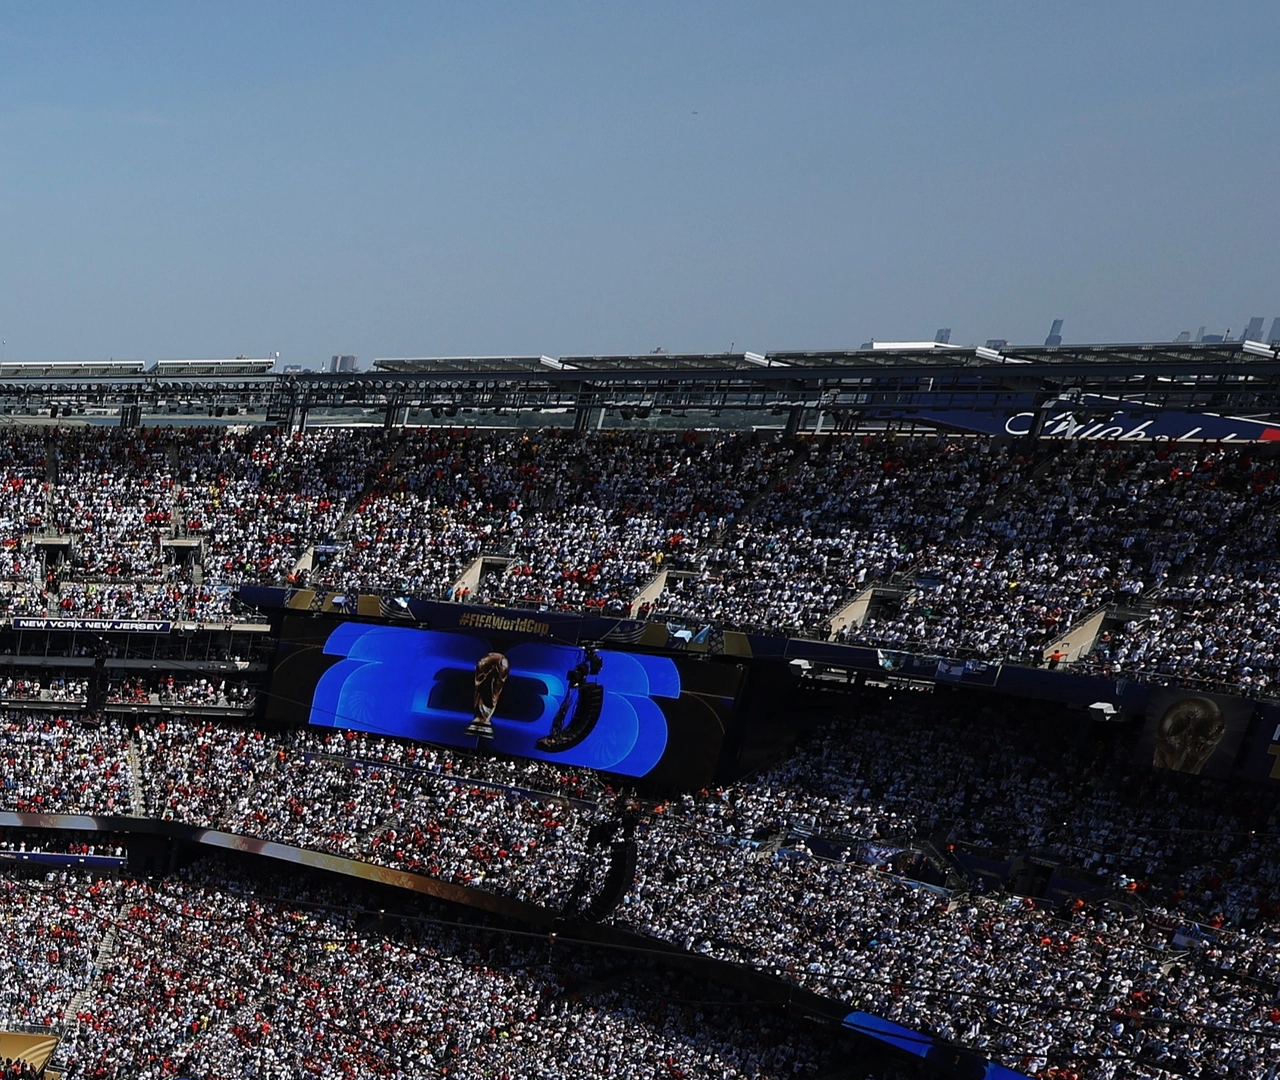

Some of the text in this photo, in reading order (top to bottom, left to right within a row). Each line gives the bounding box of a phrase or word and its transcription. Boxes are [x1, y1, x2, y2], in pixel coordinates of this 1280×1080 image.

[50, 621, 83, 629] YORK
[85, 622, 112, 630] NEW
[115, 623, 163, 631] JERSEY
[459, 612, 550, 636] #FIFAWorldCup
